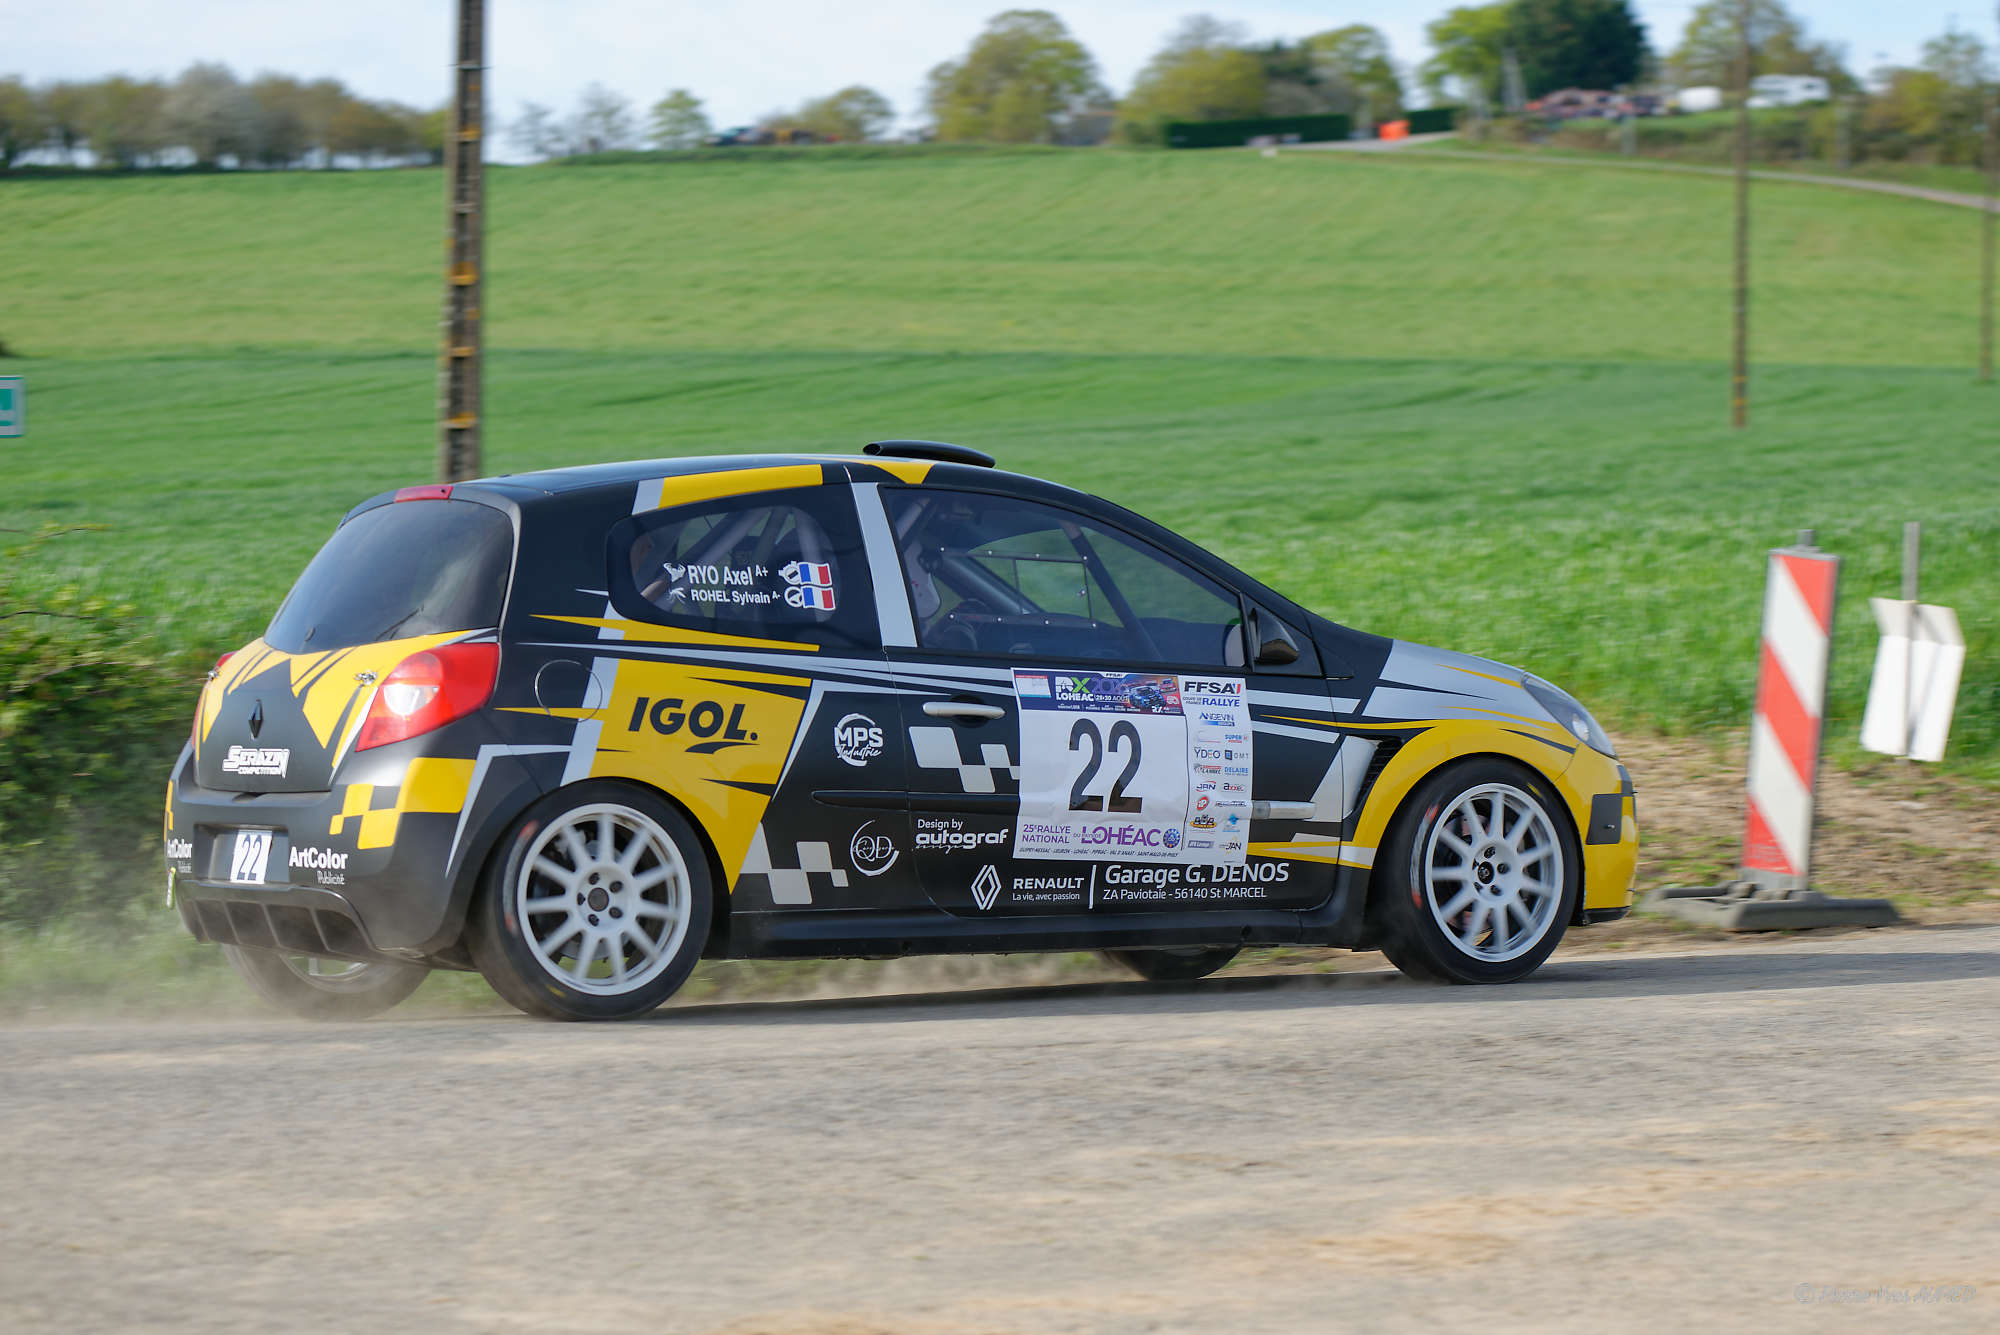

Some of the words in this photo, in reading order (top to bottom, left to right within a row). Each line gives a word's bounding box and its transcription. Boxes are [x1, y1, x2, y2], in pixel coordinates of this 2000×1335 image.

[688, 565, 719, 585] RYO
[723, 565, 753, 586] Axel
[755, 565, 769, 577] A+
[691, 589, 730, 603] ROHEL
[732, 590, 770, 604] Sylvain
[1184, 681, 1235, 694] FFSA
[1202, 697, 1240, 707] RALLYE
[834, 727, 884, 747] MPS
[1068, 718, 1143, 813] 22
[917, 819, 950, 830] Design
[951, 818, 963, 830] by
[1037, 825, 1071, 834] RALLYE
[915, 828, 1008, 849] autograf
[1022, 834, 1070, 844] NATIONAL
[1081, 825, 1161, 847] LOHÉAC
[236, 833, 264, 881] 22
[289, 846, 348, 870] ArtColor
[1105, 864, 1180, 888] Garage
[1186, 863, 1206, 883] G.
[1211, 863, 1290, 882] DENOS
[1013, 877, 1084, 890] RENAULT
[1012, 893, 1022, 901] La
[1053, 892, 1080, 902] passion
[1103, 889, 1119, 900] ZA
[1174, 888, 1207, 899] 56140
[1210, 888, 1221, 898] St
[1223, 887, 1267, 898] MARCEL
